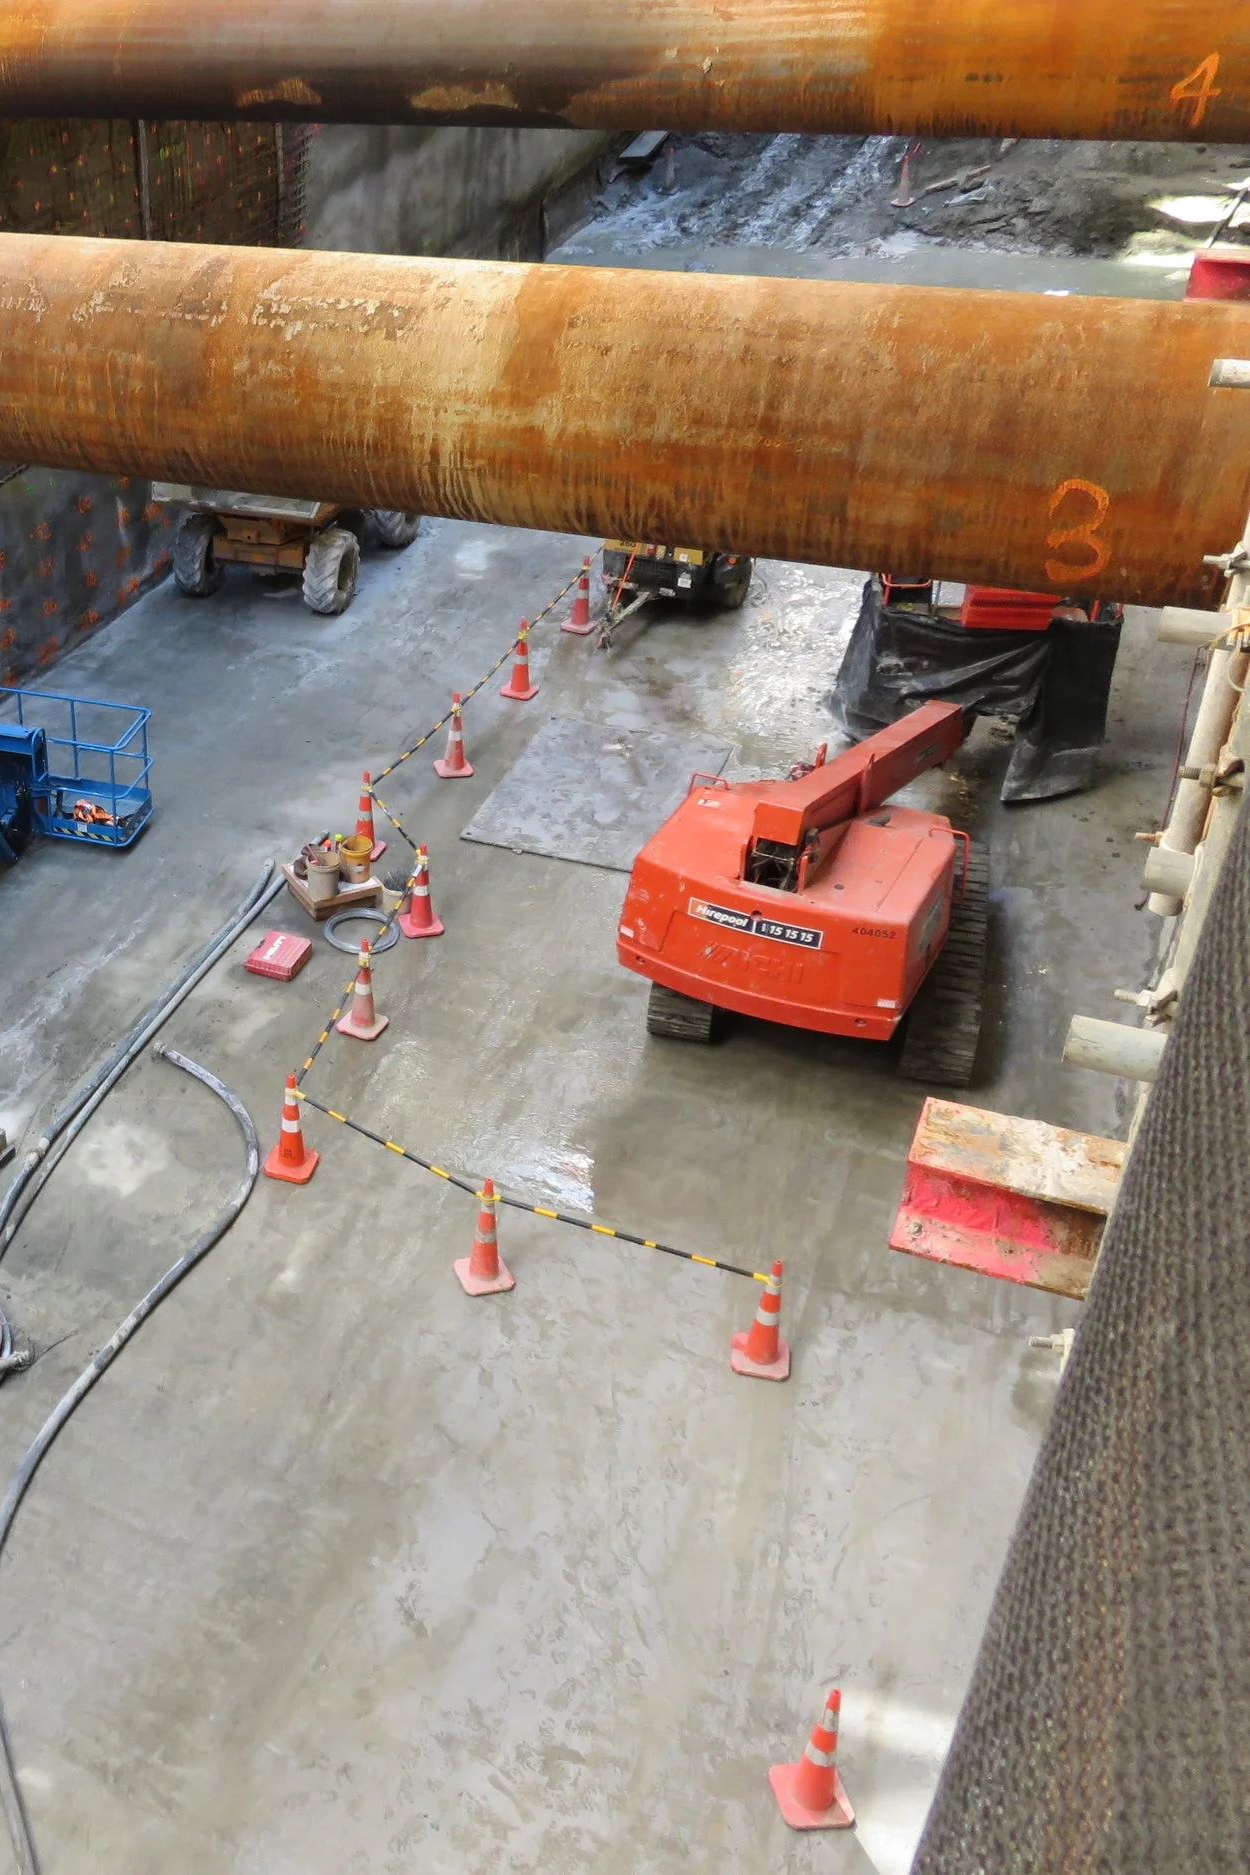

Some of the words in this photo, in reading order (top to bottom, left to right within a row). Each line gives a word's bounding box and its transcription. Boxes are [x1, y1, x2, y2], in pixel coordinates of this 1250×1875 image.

[1170, 51, 1221, 127] 4
[1045, 478, 1111, 582] 3
[696, 904, 749, 928] Hirepool
[770, 925, 784, 937] 15
[785, 929, 800, 940] 15
[800, 932, 815, 943] 15
